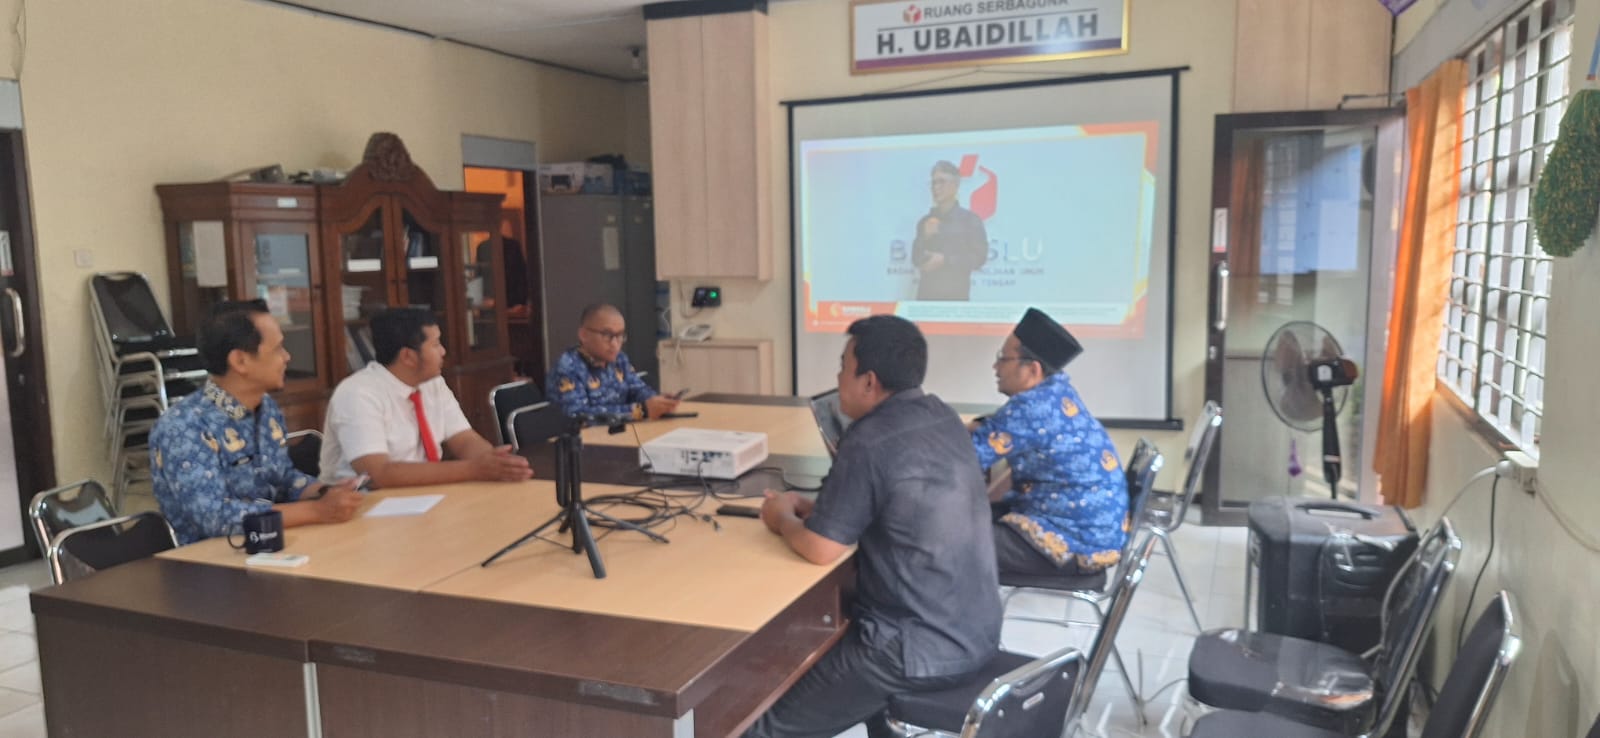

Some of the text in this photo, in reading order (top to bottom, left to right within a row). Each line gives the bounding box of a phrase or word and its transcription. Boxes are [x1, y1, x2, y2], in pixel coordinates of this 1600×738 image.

[923, 3, 973, 19] RUANG
[877, 14, 1097, 54] H. UBAIDILLAH
